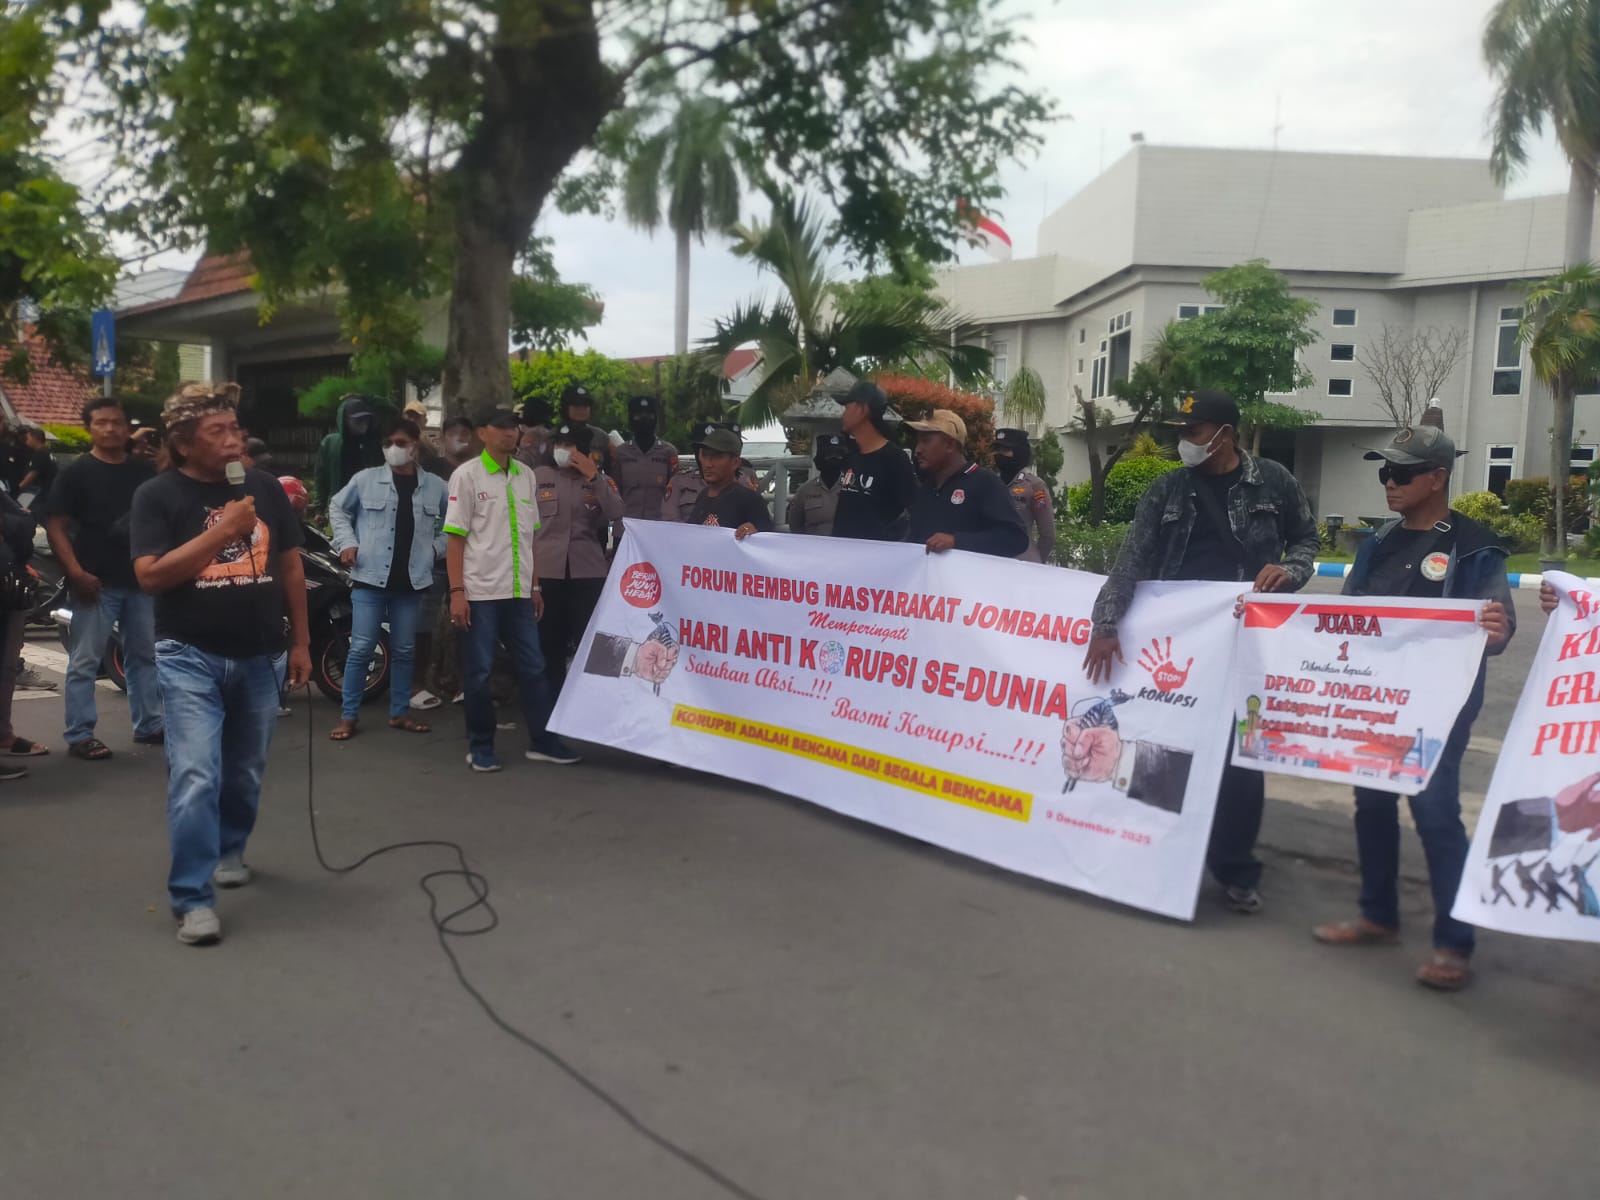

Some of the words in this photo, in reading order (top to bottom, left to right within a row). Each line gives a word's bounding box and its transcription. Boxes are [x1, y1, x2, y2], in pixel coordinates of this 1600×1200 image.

[681, 565, 738, 594] FORUM
[742, 573, 819, 605] REMBUG
[825, 583, 961, 624] MASYARAKAT
[963, 602, 1091, 646] JOMBANG
[808, 610, 910, 643] Memperingati
[1314, 613, 1382, 637] JUARA
[1337, 641, 1349, 661] 1
[679, 618, 728, 654] HARI
[735, 628, 791, 666] ANTI
[921, 659, 1069, 721] SE-DUNIA
[685, 653, 750, 684] Satukan
[1264, 674, 1316, 694] DPMD
[1318, 681, 1410, 705] JOMBANG
[1545, 671, 1600, 707] GR
[831, 697, 891, 729] Basmi
[1332, 704, 1398, 726] Korupsi
[676, 709, 737, 734] KORUPSI
[738, 724, 790, 746] ADALAH
[791, 736, 848, 763] BENCANA
[851, 754, 880, 773] DARI
[884, 762, 937, 791] SEGALA
[941, 779, 1024, 814] BENCANA
